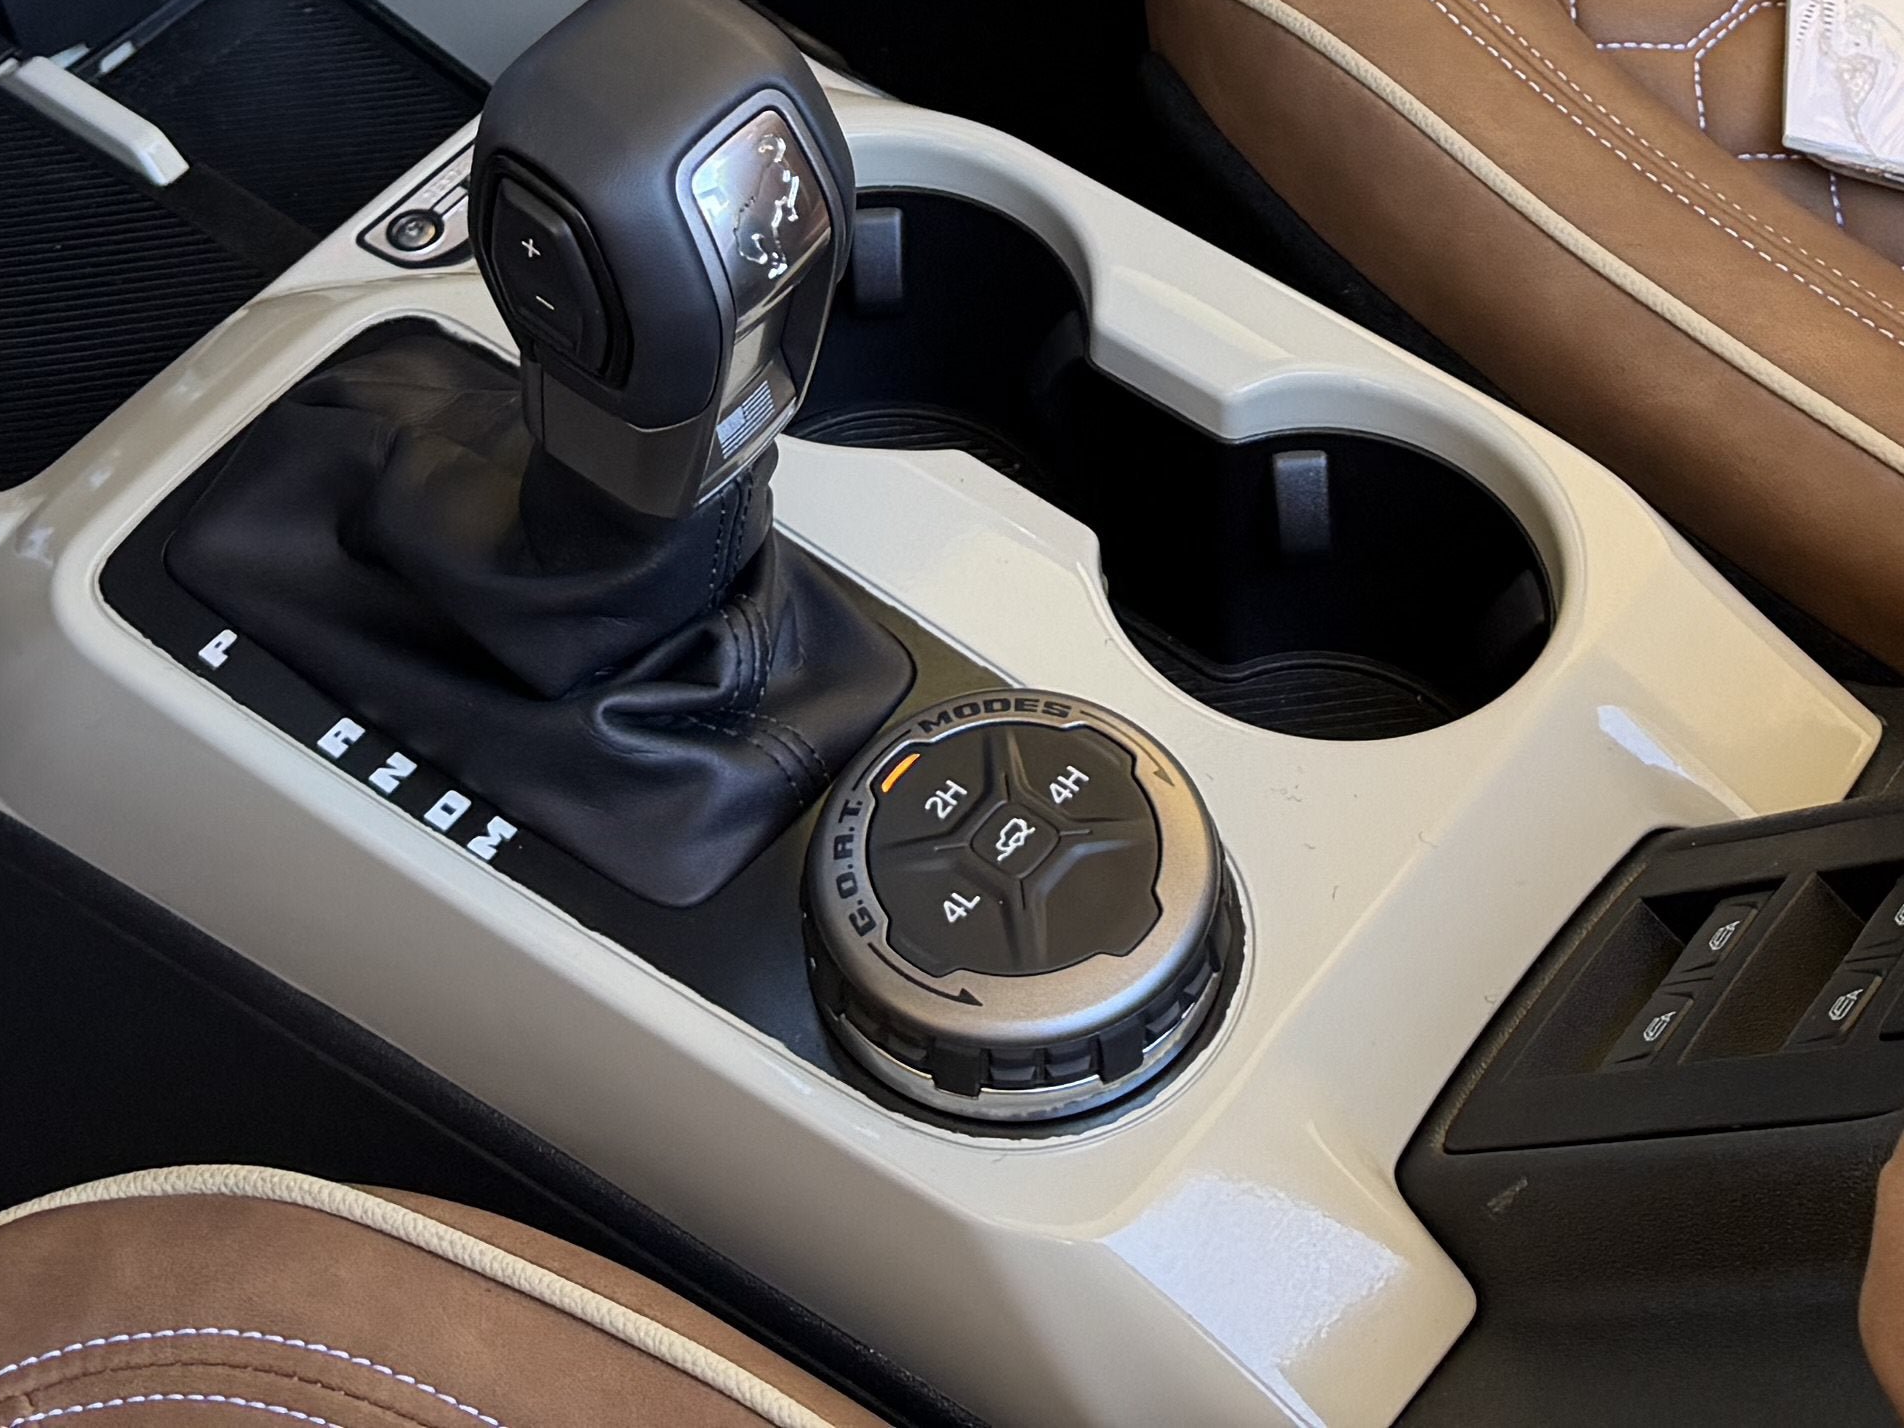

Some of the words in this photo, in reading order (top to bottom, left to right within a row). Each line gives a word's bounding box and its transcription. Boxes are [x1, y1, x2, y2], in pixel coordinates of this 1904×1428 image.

[198, 628, 239, 671] P
[317, 717, 366, 760] R
[368, 751, 418, 794] N
[423, 789, 472, 832] D
[467, 815, 519, 861] M
[925, 778, 968, 821] 2H
[1048, 765, 1090, 807] 4H
[835, 797, 878, 938] G.O.A.T.
[918, 697, 1072, 735] MODES
[942, 891, 982, 924] 4L
